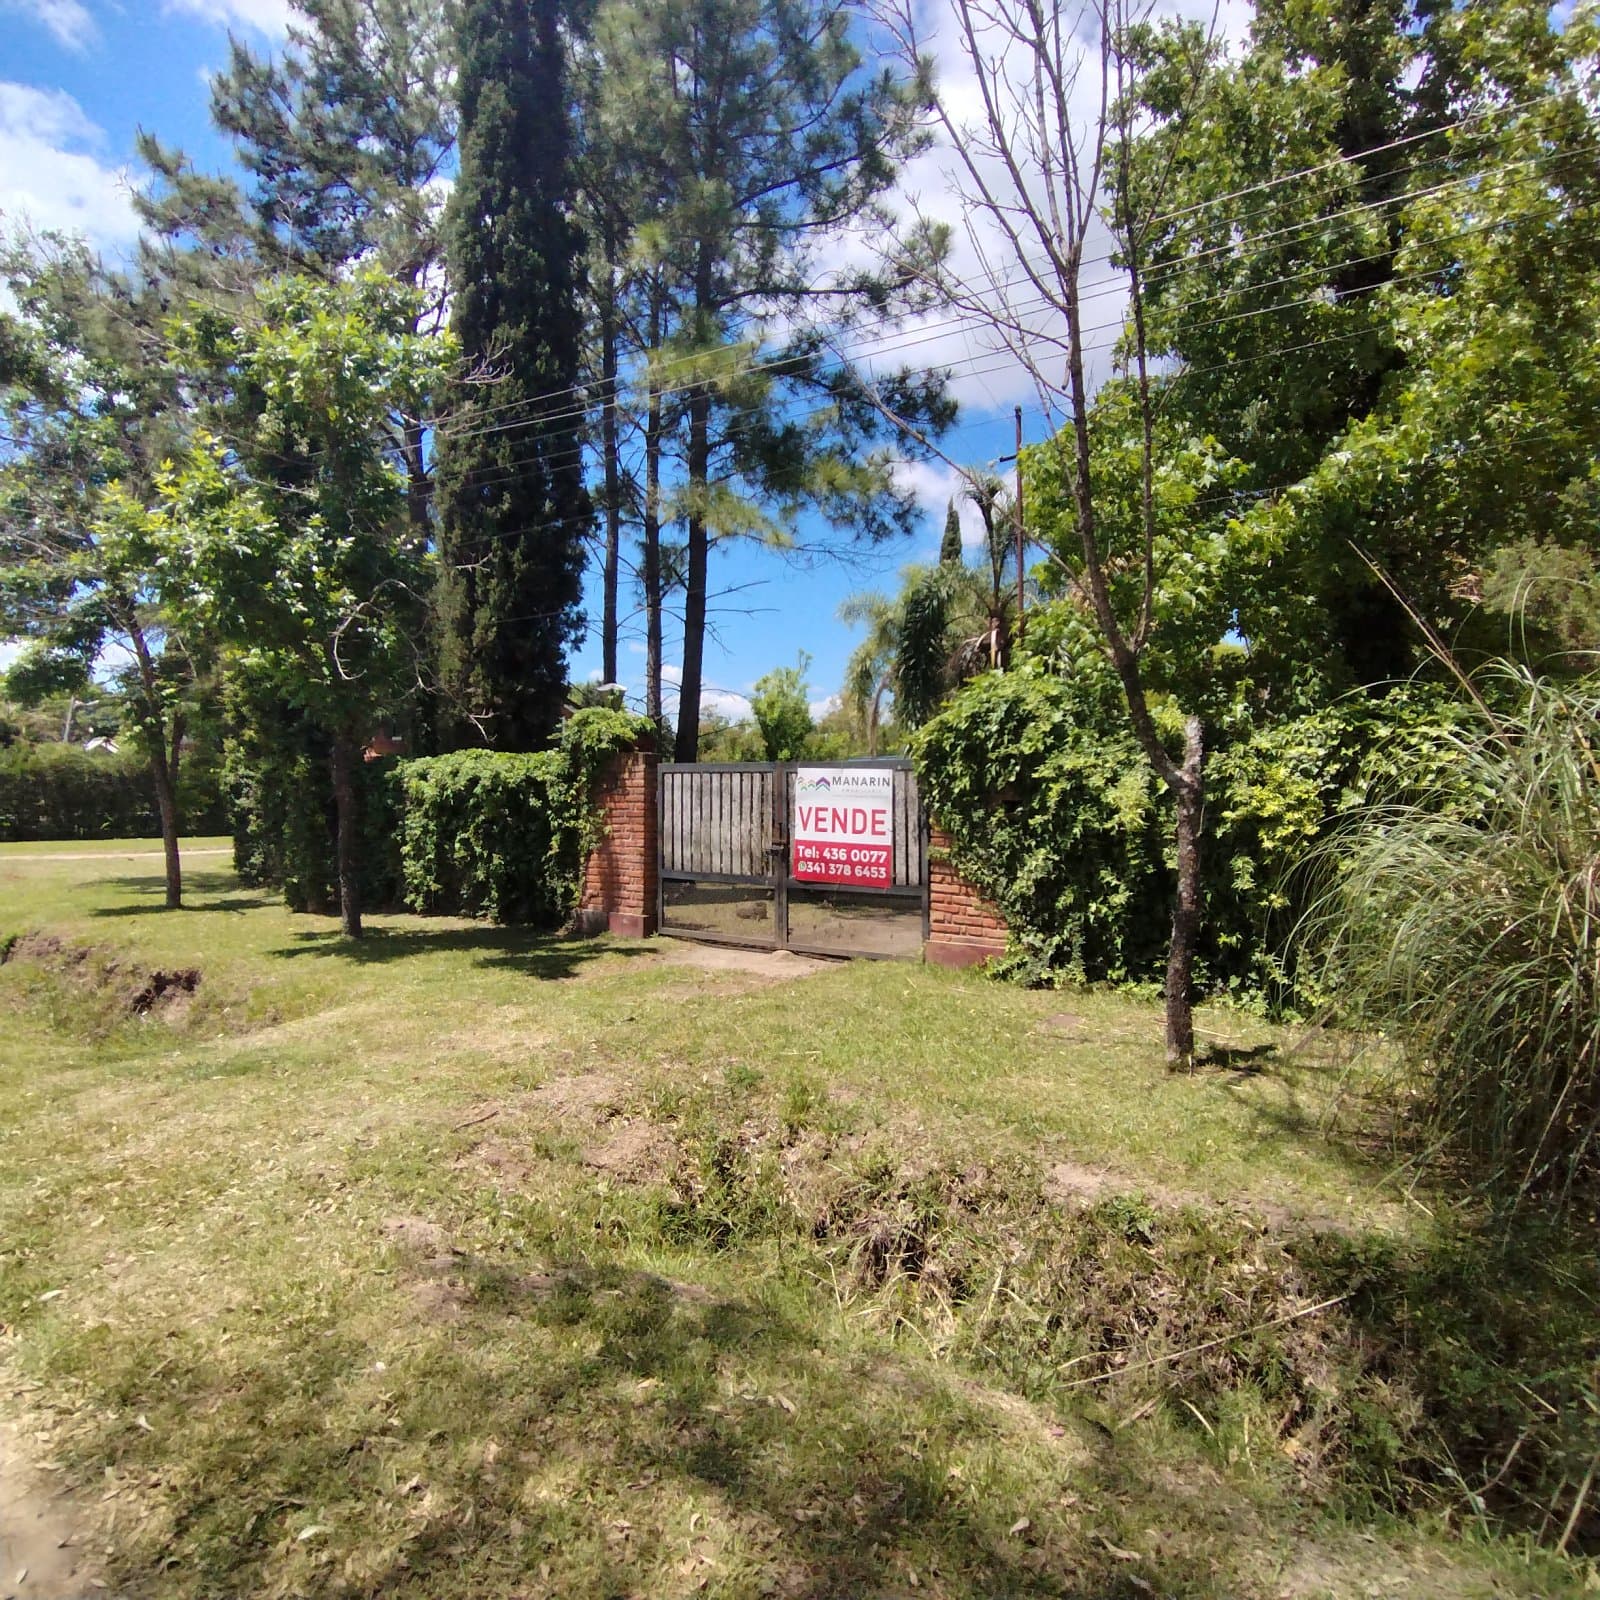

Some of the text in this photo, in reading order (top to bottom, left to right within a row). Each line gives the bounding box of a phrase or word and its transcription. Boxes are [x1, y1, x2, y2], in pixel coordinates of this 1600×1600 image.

[832, 776, 890, 787] MANARIN
[799, 806, 887, 836] VENDE
[797, 845, 887, 863] Tel: 436 0077
[806, 861, 887, 879] 341 378 6453
